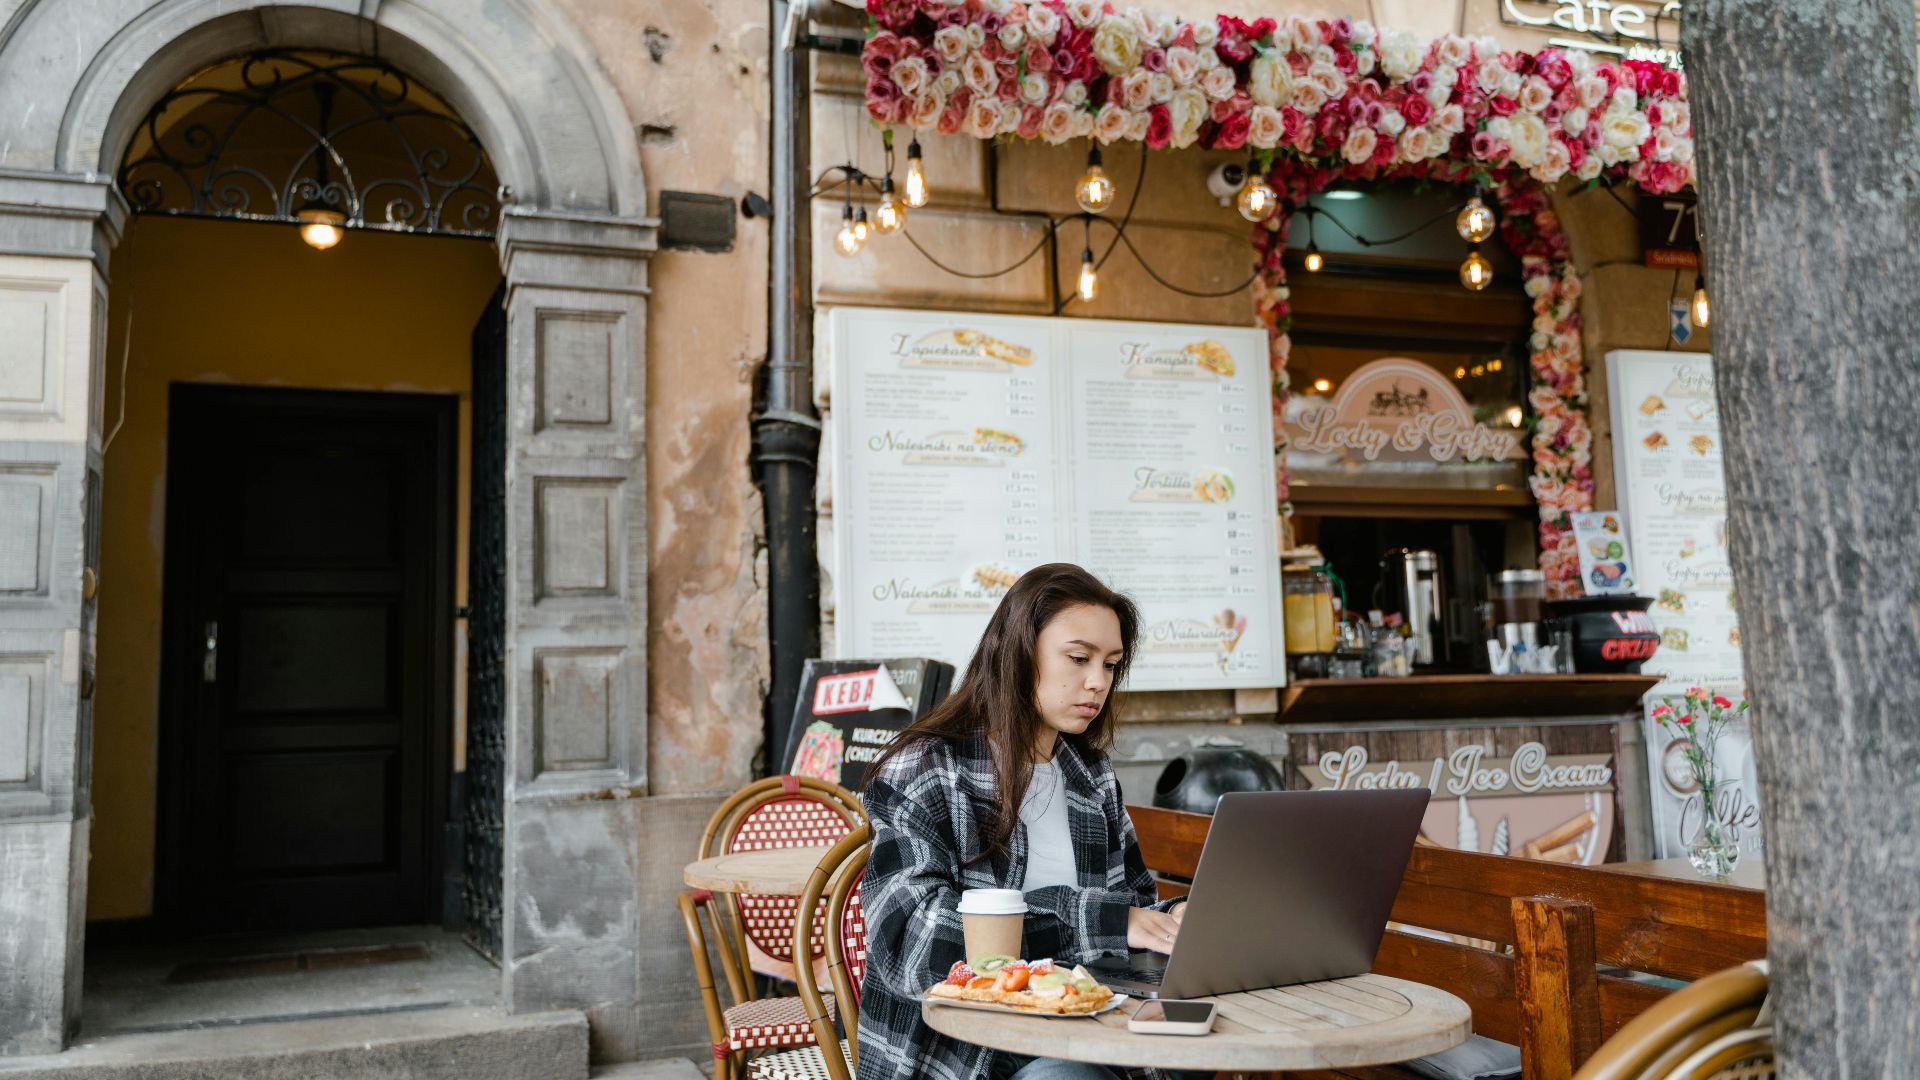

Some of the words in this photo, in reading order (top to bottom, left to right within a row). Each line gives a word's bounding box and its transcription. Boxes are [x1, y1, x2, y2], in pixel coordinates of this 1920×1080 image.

[1295, 405, 1389, 460] Lody
[1393, 422, 1424, 450] &
[1415, 410, 1516, 461] Gofry
[823, 678, 875, 706] KEBA
[1319, 745, 1422, 790] Lody
[1447, 744, 1510, 796] Ice
[1510, 741, 1612, 793] Cream
[1679, 787, 1760, 848] Cffe
